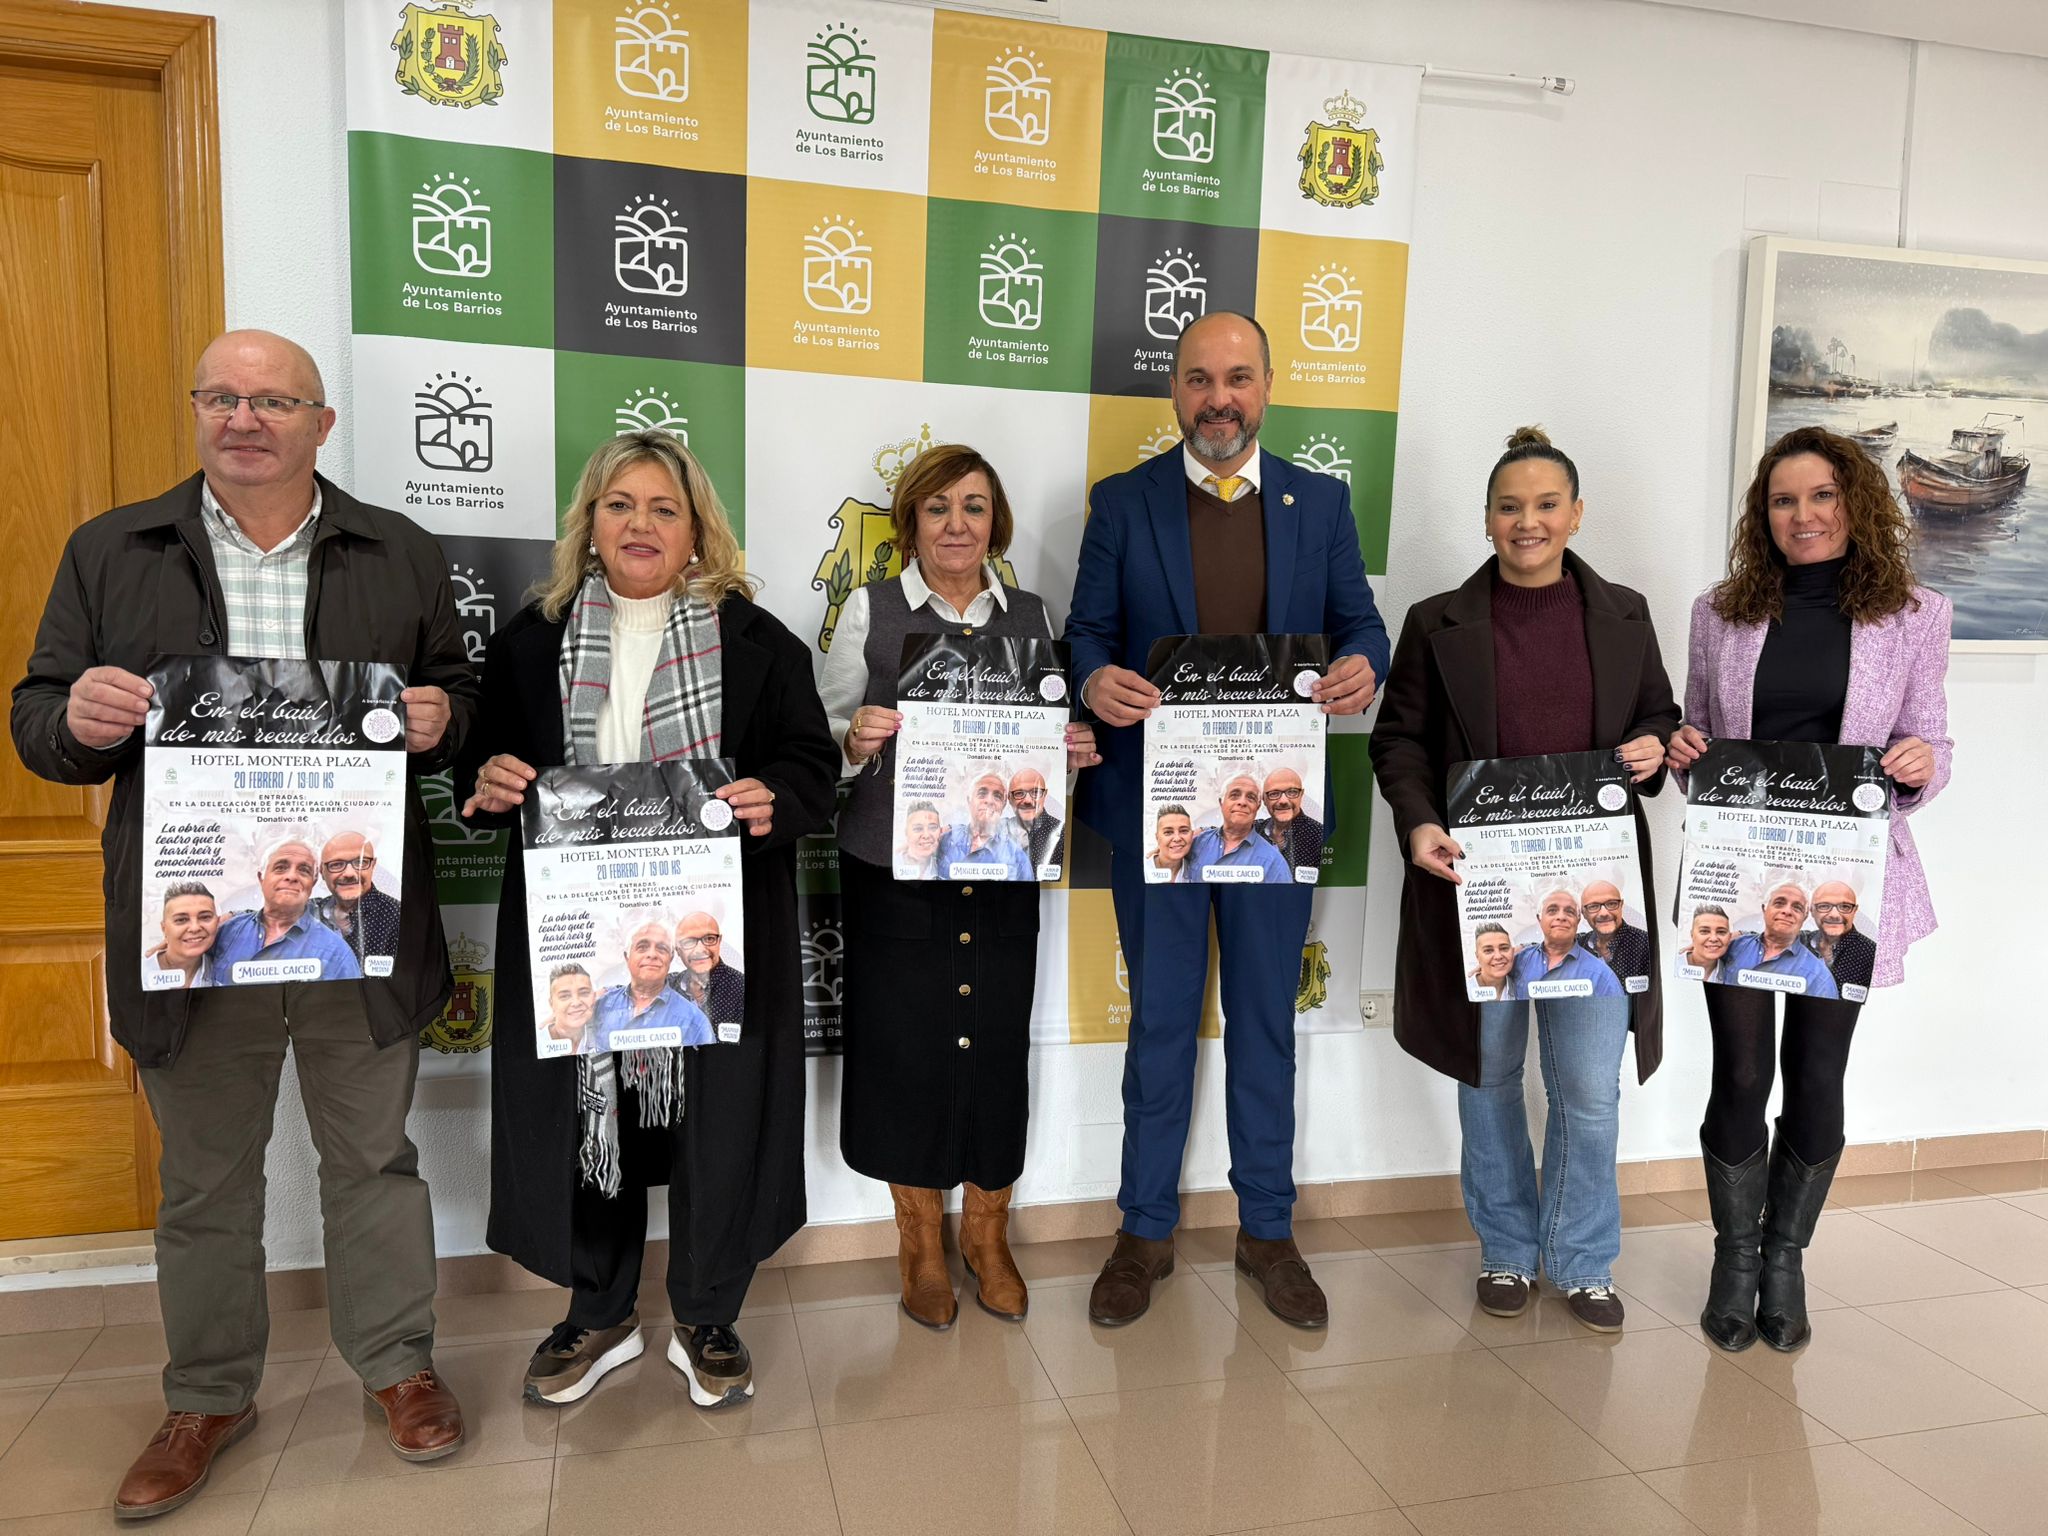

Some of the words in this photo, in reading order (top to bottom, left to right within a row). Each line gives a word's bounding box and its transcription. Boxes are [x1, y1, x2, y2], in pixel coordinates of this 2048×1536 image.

[605, 106, 699, 127] Ayuntamiento
[605, 119, 621, 131] de
[625, 122, 649, 134] Los
[653, 125, 699, 141] Barrios
[795, 129, 884, 148] Ayuntamiento
[795, 142, 811, 153] de
[815, 144, 836, 157] Los
[840, 147, 883, 162] Barrios
[974, 150, 1057, 169] Ayuntamiento
[974, 162, 989, 174] de
[992, 164, 1013, 176] Los
[1016, 167, 1056, 182] Barrios
[1142, 168, 1221, 186] Ayuntamiento
[1142, 181, 1156, 192] de
[1160, 182, 1180, 193] Los
[1183, 184, 1220, 199] Barrios
[402, 282, 502, 302] Ayuntamiento
[402, 296, 420, 308] de
[425, 298, 449, 311] Los
[454, 302, 502, 316] Barrios
[605, 302, 698, 321] Ayuntamiento
[605, 315, 621, 327] de
[625, 317, 648, 329] Los
[652, 319, 698, 334] Barrios
[793, 320, 880, 337] Ayuntamiento
[793, 333, 809, 344] de
[812, 335, 834, 346] Los
[837, 337, 880, 351] Barrios
[968, 336, 1049, 352] Ayuntamiento
[968, 348, 983, 359] de
[986, 350, 1005, 361] Los
[1009, 352, 1049, 365] Barrios
[1290, 359, 1367, 372] Ayuntamiento
[1134, 360, 1148, 371] de
[1151, 362, 1170, 372] Los
[1290, 371, 1303, 381] de
[1305, 373, 1324, 383] Los
[1327, 373, 1366, 384] Barrios
[405, 480, 504, 496] Ayuntamiento
[405, 493, 423, 505] de
[427, 495, 451, 506] Los
[456, 496, 504, 509] Barrios
[926, 659, 953, 680] En
[957, 665, 974, 681] el
[978, 666, 1016, 683] baúl
[1173, 662, 1201, 682] En
[1206, 666, 1224, 681] el
[1229, 665, 1268, 681] baúl
[907, 681, 930, 698] de
[932, 685, 962, 699] mis
[966, 683, 1036, 702] recuerdos
[1181, 688, 1211, 701] mis
[1216, 683, 1290, 700] recuerdos
[190, 690, 232, 718] En
[239, 697, 265, 719] el
[272, 698, 328, 721] baúl
[925, 706, 960, 716] HOTEL
[961, 708, 1010, 718] MONTERA
[1014, 710, 1045, 720] PLAZA
[1173, 710, 1209, 718] HOTEL
[1211, 709, 1263, 717] MONTERA
[1267, 708, 1300, 717] PLAZA
[160, 720, 196, 742] de
[201, 725, 247, 743] mis
[254, 722, 358, 745] recuerdos
[190, 754, 244, 766] HOTEL
[247, 755, 321, 767] MONTERA
[326, 756, 371, 767] PLAZA
[234, 771, 245, 788] 20
[248, 771, 283, 788] FEBRERO
[286, 771, 293, 788] /
[322, 772, 334, 788] HS
[1719, 765, 1750, 786] En
[1755, 771, 1776, 787] el
[1779, 773, 1825, 791] baúl
[1473, 784, 1504, 805] En
[1507, 785, 1527, 801] el
[1530, 782, 1571, 801] baúl
[1697, 785, 1723, 803] de
[1726, 790, 1760, 805] mis
[1765, 790, 1849, 812] recuerdos
[595, 799, 618, 818] el
[623, 796, 670, 817] baúl
[1456, 807, 1482, 824] de
[1484, 807, 1516, 822] mis
[1519, 798, 1596, 819] recuerdos
[160, 823, 175, 833] La
[177, 823, 205, 833] obra
[206, 822, 221, 832] de
[533, 823, 562, 844] de
[567, 825, 604, 842] mis
[610, 815, 698, 839] recuerdos
[1479, 828, 1516, 838] HOTEL
[1517, 824, 1571, 836] MONTERA
[1574, 822, 1609, 832] PLAZA
[1717, 811, 1756, 822] HOTEL
[1759, 814, 1817, 827] MONTERA
[1820, 819, 1859, 831] PLAZA
[155, 834, 191, 844] teatro
[191, 836, 212, 846] que
[212, 834, 225, 843] te
[159, 845, 189, 855] hará
[211, 847, 221, 857] y
[560, 850, 603, 862] HOTEL
[606, 846, 668, 859] MONTERA
[672, 844, 711, 856] PLAZA
[154, 855, 226, 867] emocionarte
[155, 870, 186, 878] como
[187, 869, 223, 877] nunca
[1206, 868, 1234, 878] MIGUEL
[1236, 869, 1259, 877] CAICEO
[238, 964, 279, 978] MIGUEL
[282, 963, 315, 974] CAICEO
[1532, 983, 1562, 994] MIGUEL
[1563, 983, 1588, 991] CAICEO
[1742, 972, 1773, 985] MIGUEL
[1775, 977, 1801, 988] CAICEO
